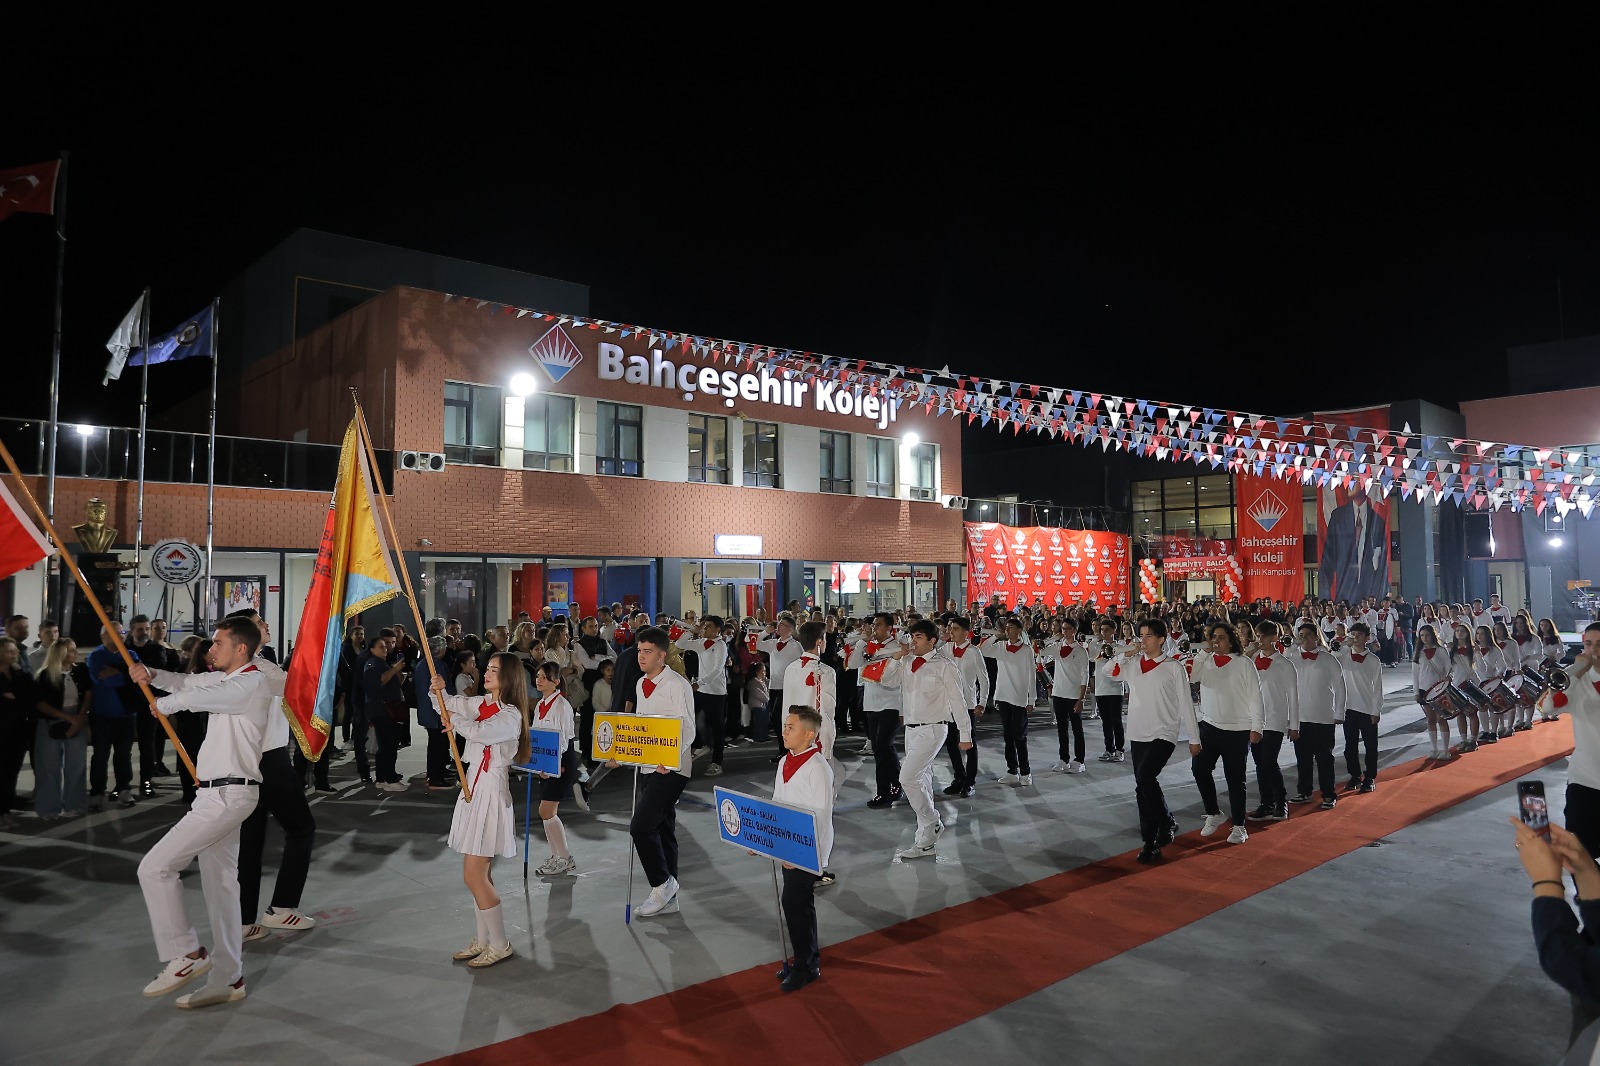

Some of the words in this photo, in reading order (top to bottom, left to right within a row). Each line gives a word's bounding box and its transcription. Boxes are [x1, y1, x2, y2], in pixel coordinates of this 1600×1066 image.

[598, 342, 808, 407] Bahçeşehir
[816, 379, 898, 430] Koleji
[1241, 534, 1298, 548] Bahçeşehir
[1253, 551, 1284, 565] Koleji
[1262, 567, 1296, 577] Kampüsü
[659, 736, 678, 748] KOLEJİ
[615, 746, 626, 755] FEN
[626, 745, 643, 757] LİSESİ
[741, 815, 756, 829] ÖZEL
[756, 821, 792, 840] BAHÇEŞEHİR
[792, 834, 814, 847] KOLEJİ
[743, 830, 774, 848] İLKOKULU
